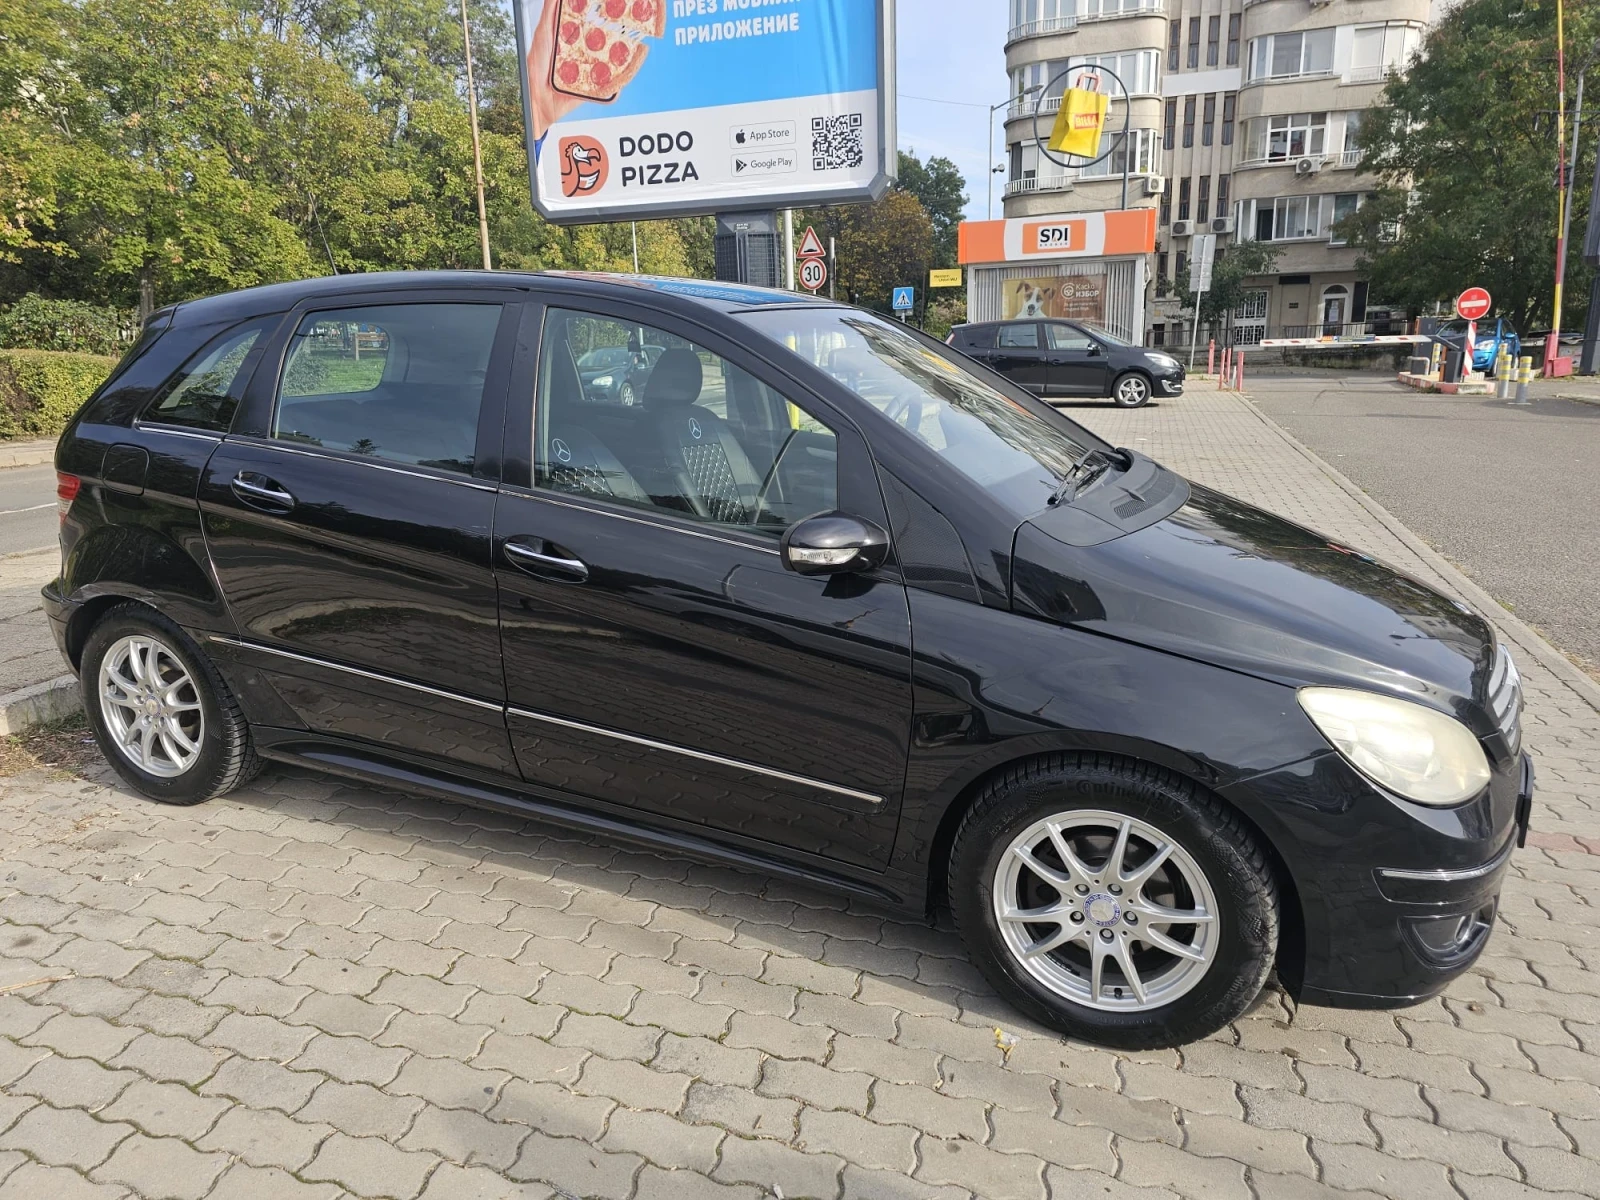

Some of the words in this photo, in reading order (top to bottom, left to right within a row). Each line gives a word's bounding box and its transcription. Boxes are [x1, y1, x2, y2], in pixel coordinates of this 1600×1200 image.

[673, 0, 718, 18] ПРЕЗ
[675, 13, 800, 46] ПРИЛОЖЕНИЕ
[619, 130, 694, 157] DODO
[749, 131, 767, 142] App
[768, 128, 790, 139] Store
[750, 158, 777, 170] Google
[778, 157, 793, 168] Play
[621, 161, 699, 187] PIZZA
[1040, 227, 1069, 243] SDI
[804, 265, 820, 282] 30
[1075, 290, 1100, 298] ИЗБОР
